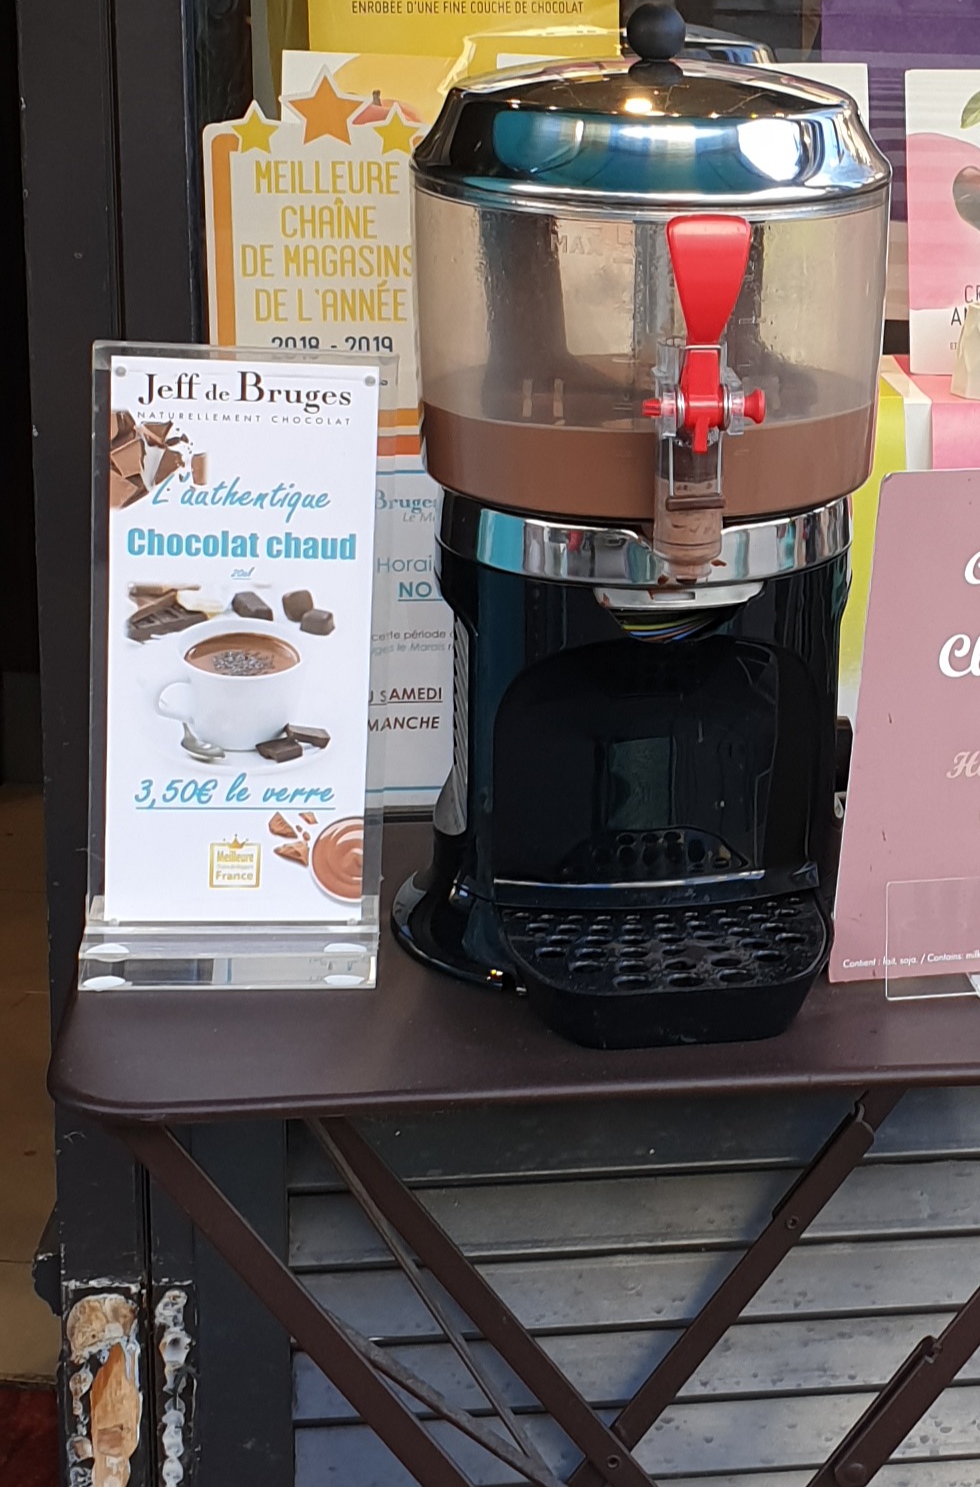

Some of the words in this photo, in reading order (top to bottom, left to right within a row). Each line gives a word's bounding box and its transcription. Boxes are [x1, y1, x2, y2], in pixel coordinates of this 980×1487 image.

[406, 0, 440, 14] D'UNE
[443, 1, 467, 14] FINE
[470, 1, 512, 14] COUCHE
[514, 1, 528, 14] DE
[531, 0, 584, 14] CHOCOLAT
[254, 160, 401, 195] MEILLEURE
[280, 197, 378, 239] CHAÎNE
[240, 243, 275, 279] DE
[254, 288, 288, 322] DE
[296, 280, 408, 322] L'ANNÉE
[138, 372, 202, 406] Jeff
[205, 384, 230, 402] de
[234, 370, 352, 413] Bruges
[137, 411, 261, 422] NATURELLEMENT
[272, 416, 351, 425] CHOCOLAT
[152, 472, 330, 523] L'authentique
[402, 511, 417, 522] Le
[127, 527, 260, 558] Chocolat
[266, 532, 356, 560] chaud
[403, 630, 446, 640] période
[408, 643, 446, 652] Marais
[380, 687, 443, 702] SAMEDI
[134, 778, 218, 810] 3,50€
[225, 772, 250, 802] le
[262, 786, 336, 803] verre
[216, 850, 254, 863] Meilleure
[215, 870, 254, 881] France
[843, 959, 876, 968] Contient
